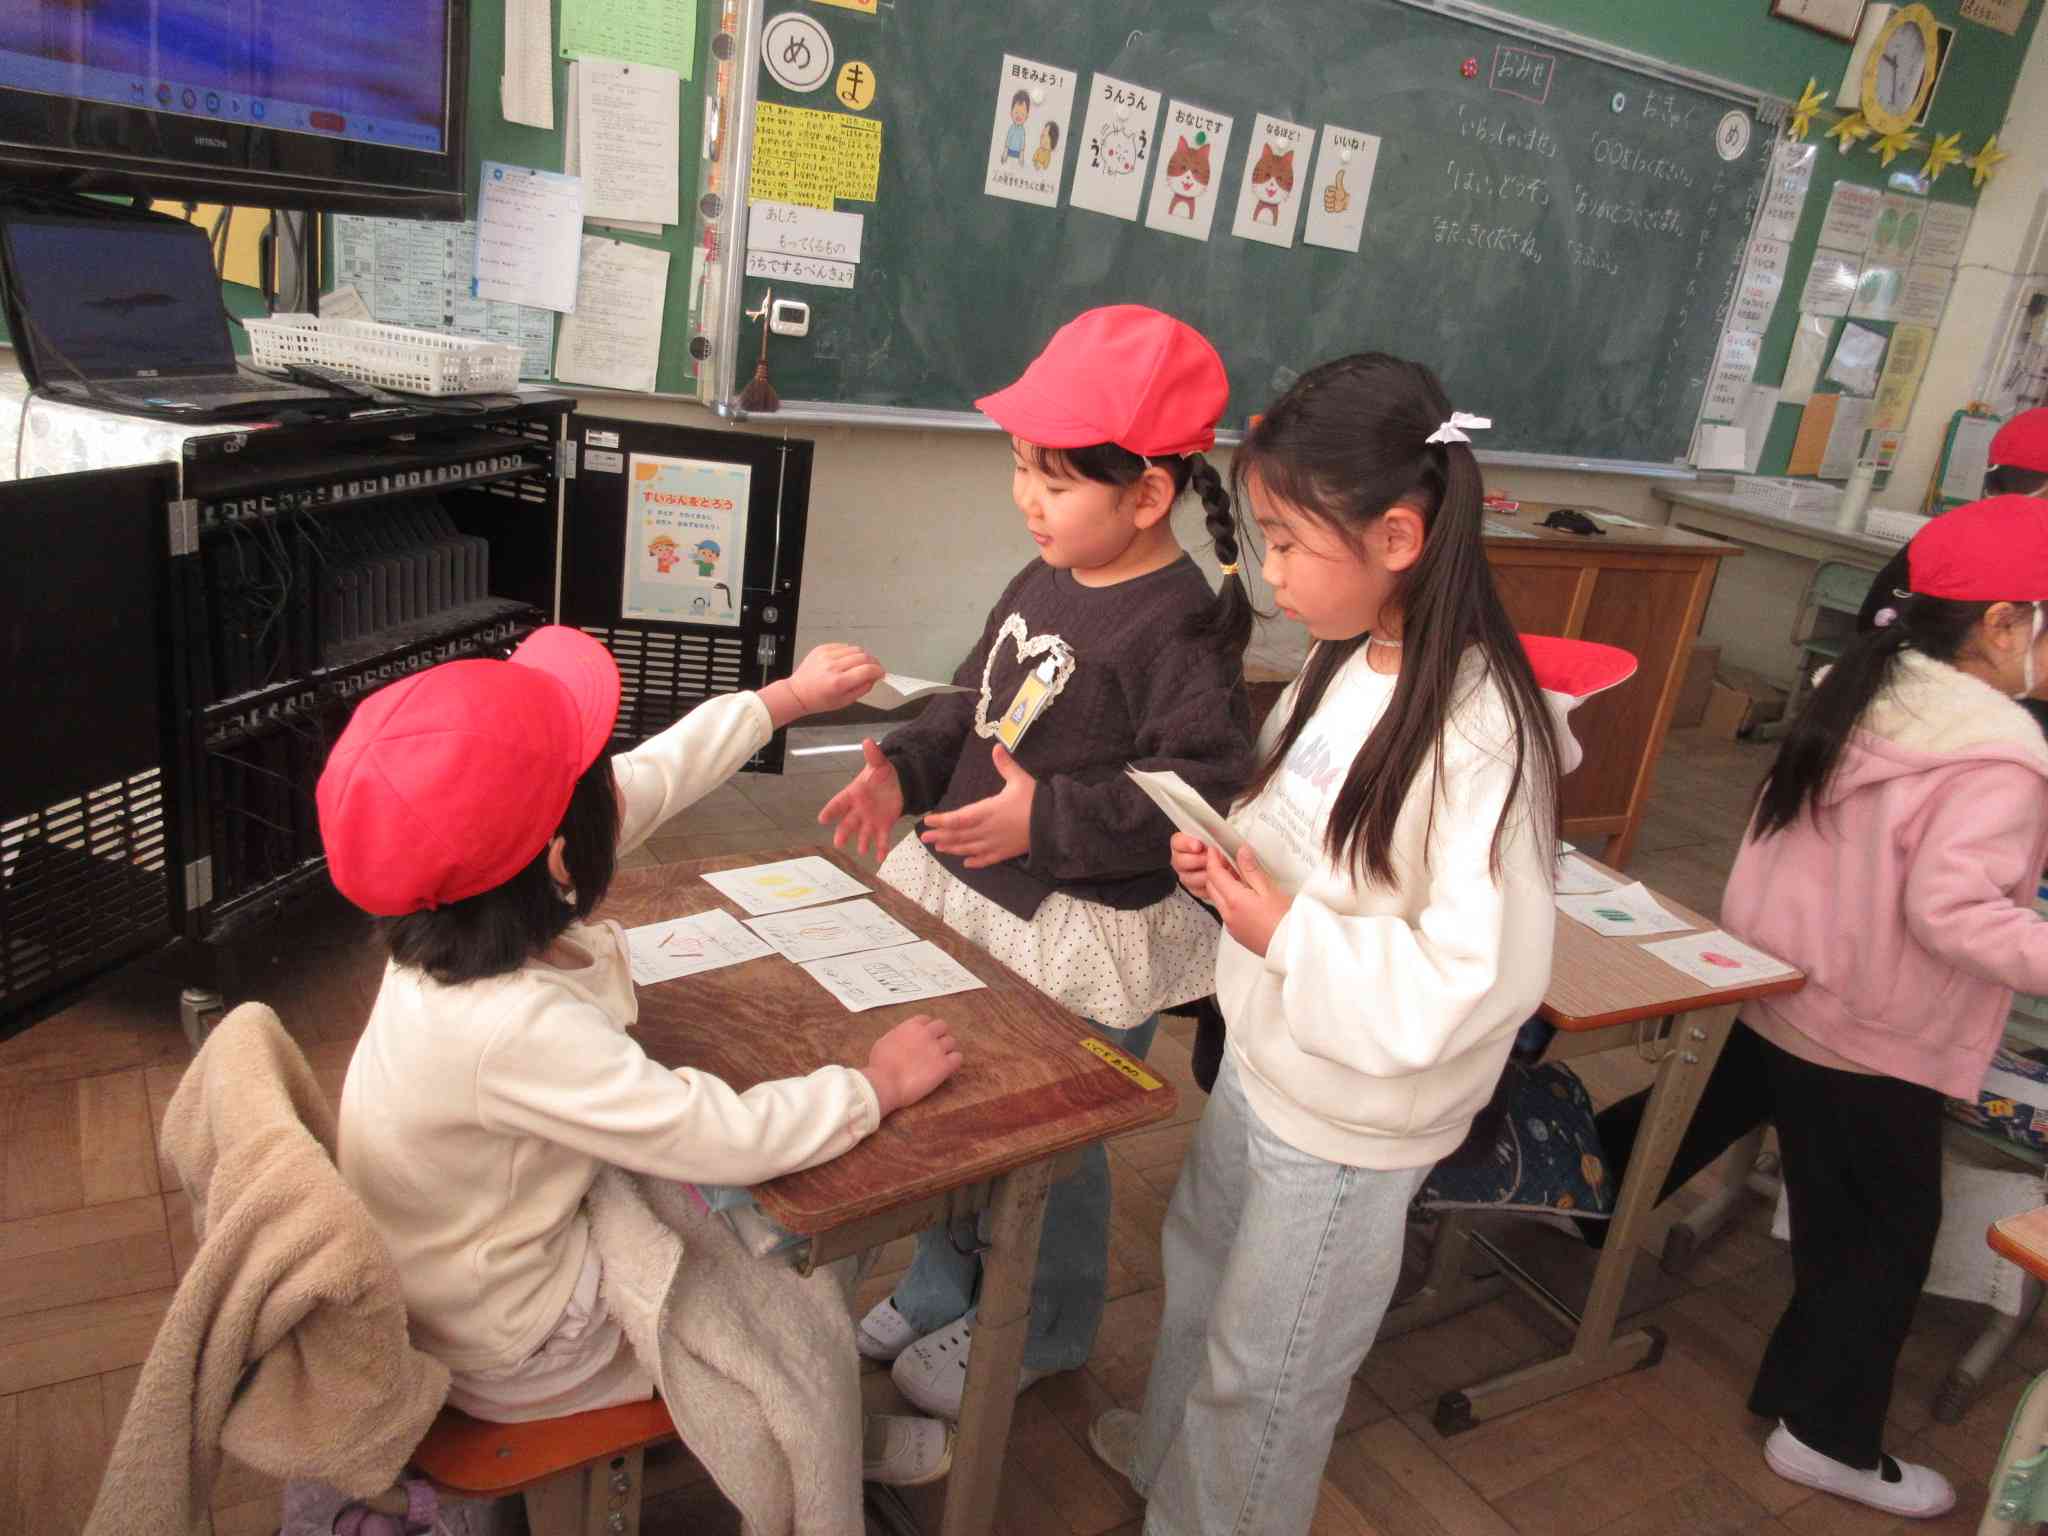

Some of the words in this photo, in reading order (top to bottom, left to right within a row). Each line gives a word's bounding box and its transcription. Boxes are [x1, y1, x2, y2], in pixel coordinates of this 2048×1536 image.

[783, 35, 811, 70] め
[1010, 64, 1064, 88] 目をみよう！
[1497, 51, 1545, 87] おみせ
[841, 64, 864, 103] ま
[1103, 85, 1148, 111] うんうん
[1175, 110, 1223, 134] おなじです
[1137, 130, 1147, 160] うん
[1725, 124, 1740, 147] め
[1090, 138, 1100, 168] うん
[766, 207, 797, 224] あした
[780, 234, 846, 256] もってくるもの
[643, 491, 735, 511] すいぶんをとろう
